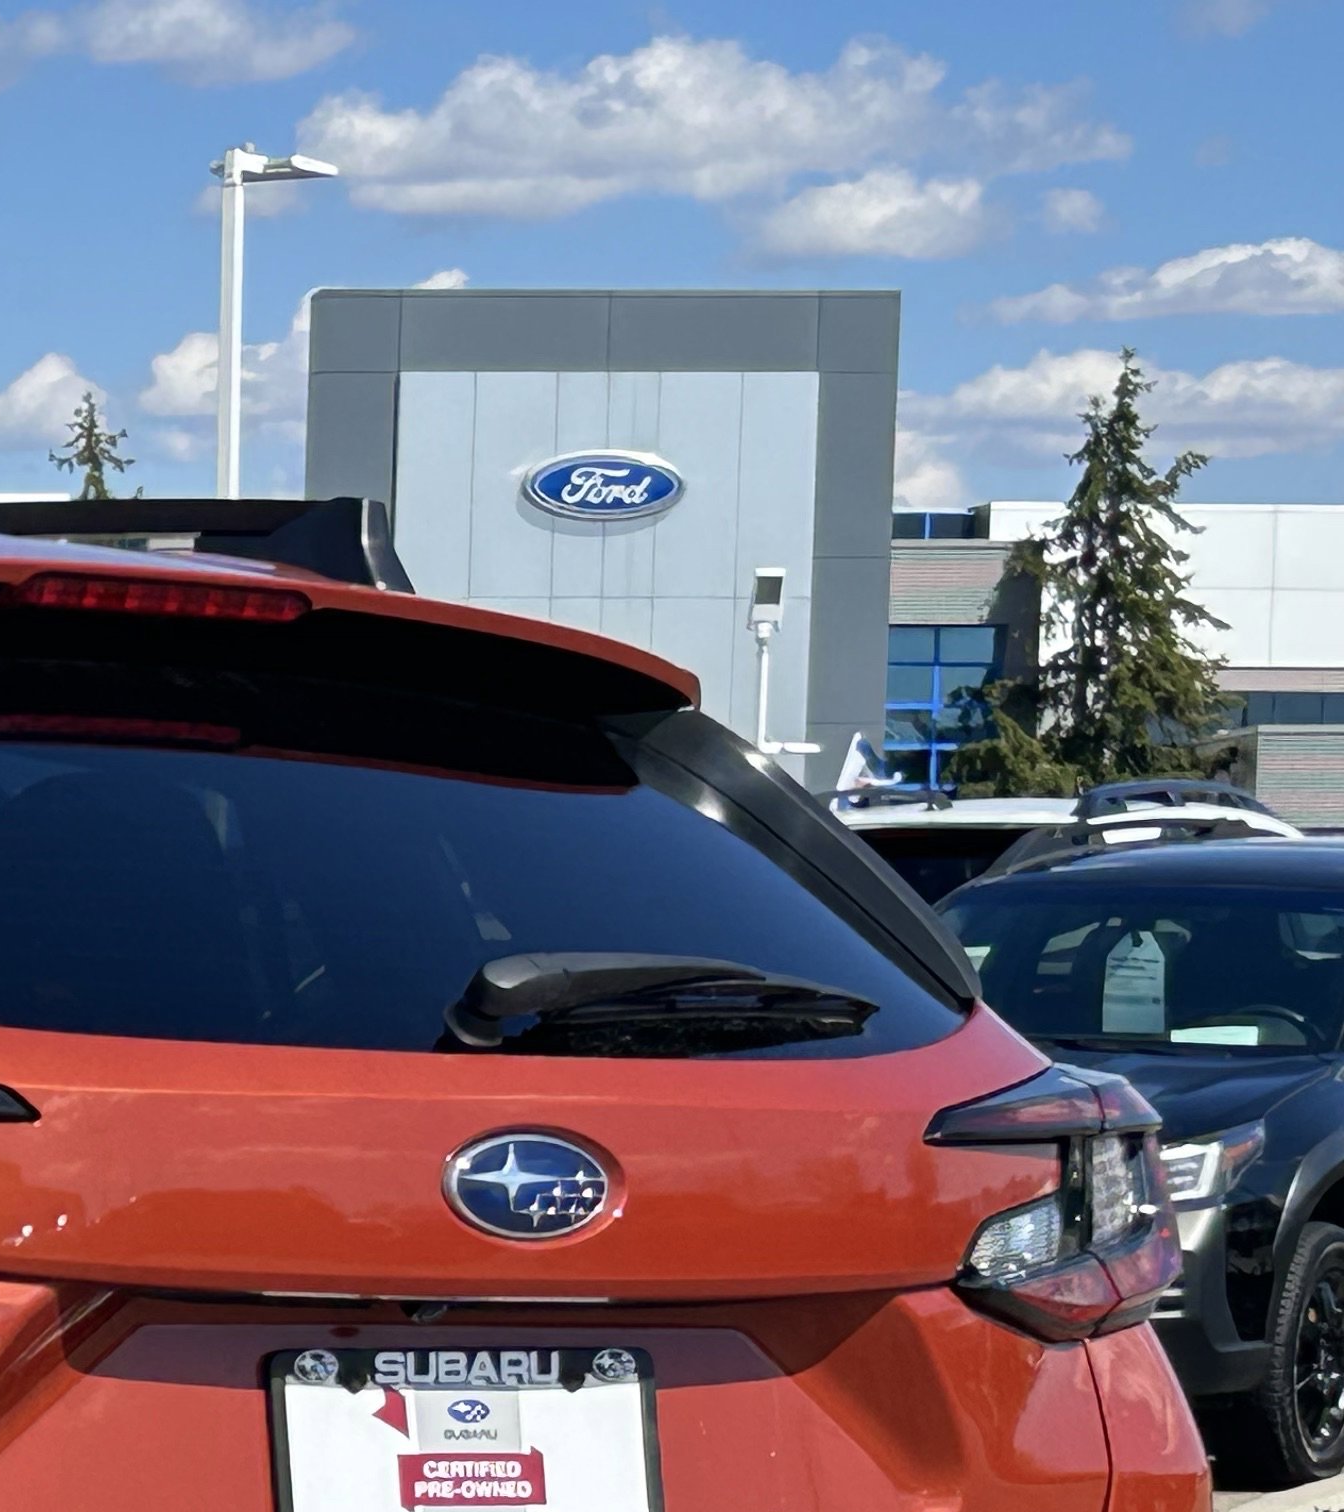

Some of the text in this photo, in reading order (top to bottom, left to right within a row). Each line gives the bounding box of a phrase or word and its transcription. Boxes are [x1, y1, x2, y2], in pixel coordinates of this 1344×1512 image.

[561, 466, 652, 505] Ford
[374, 1350, 560, 1386] SUBARU
[422, 1460, 522, 1479] CERTIFIED
[413, 1480, 533, 1499] PRE-OWNED
